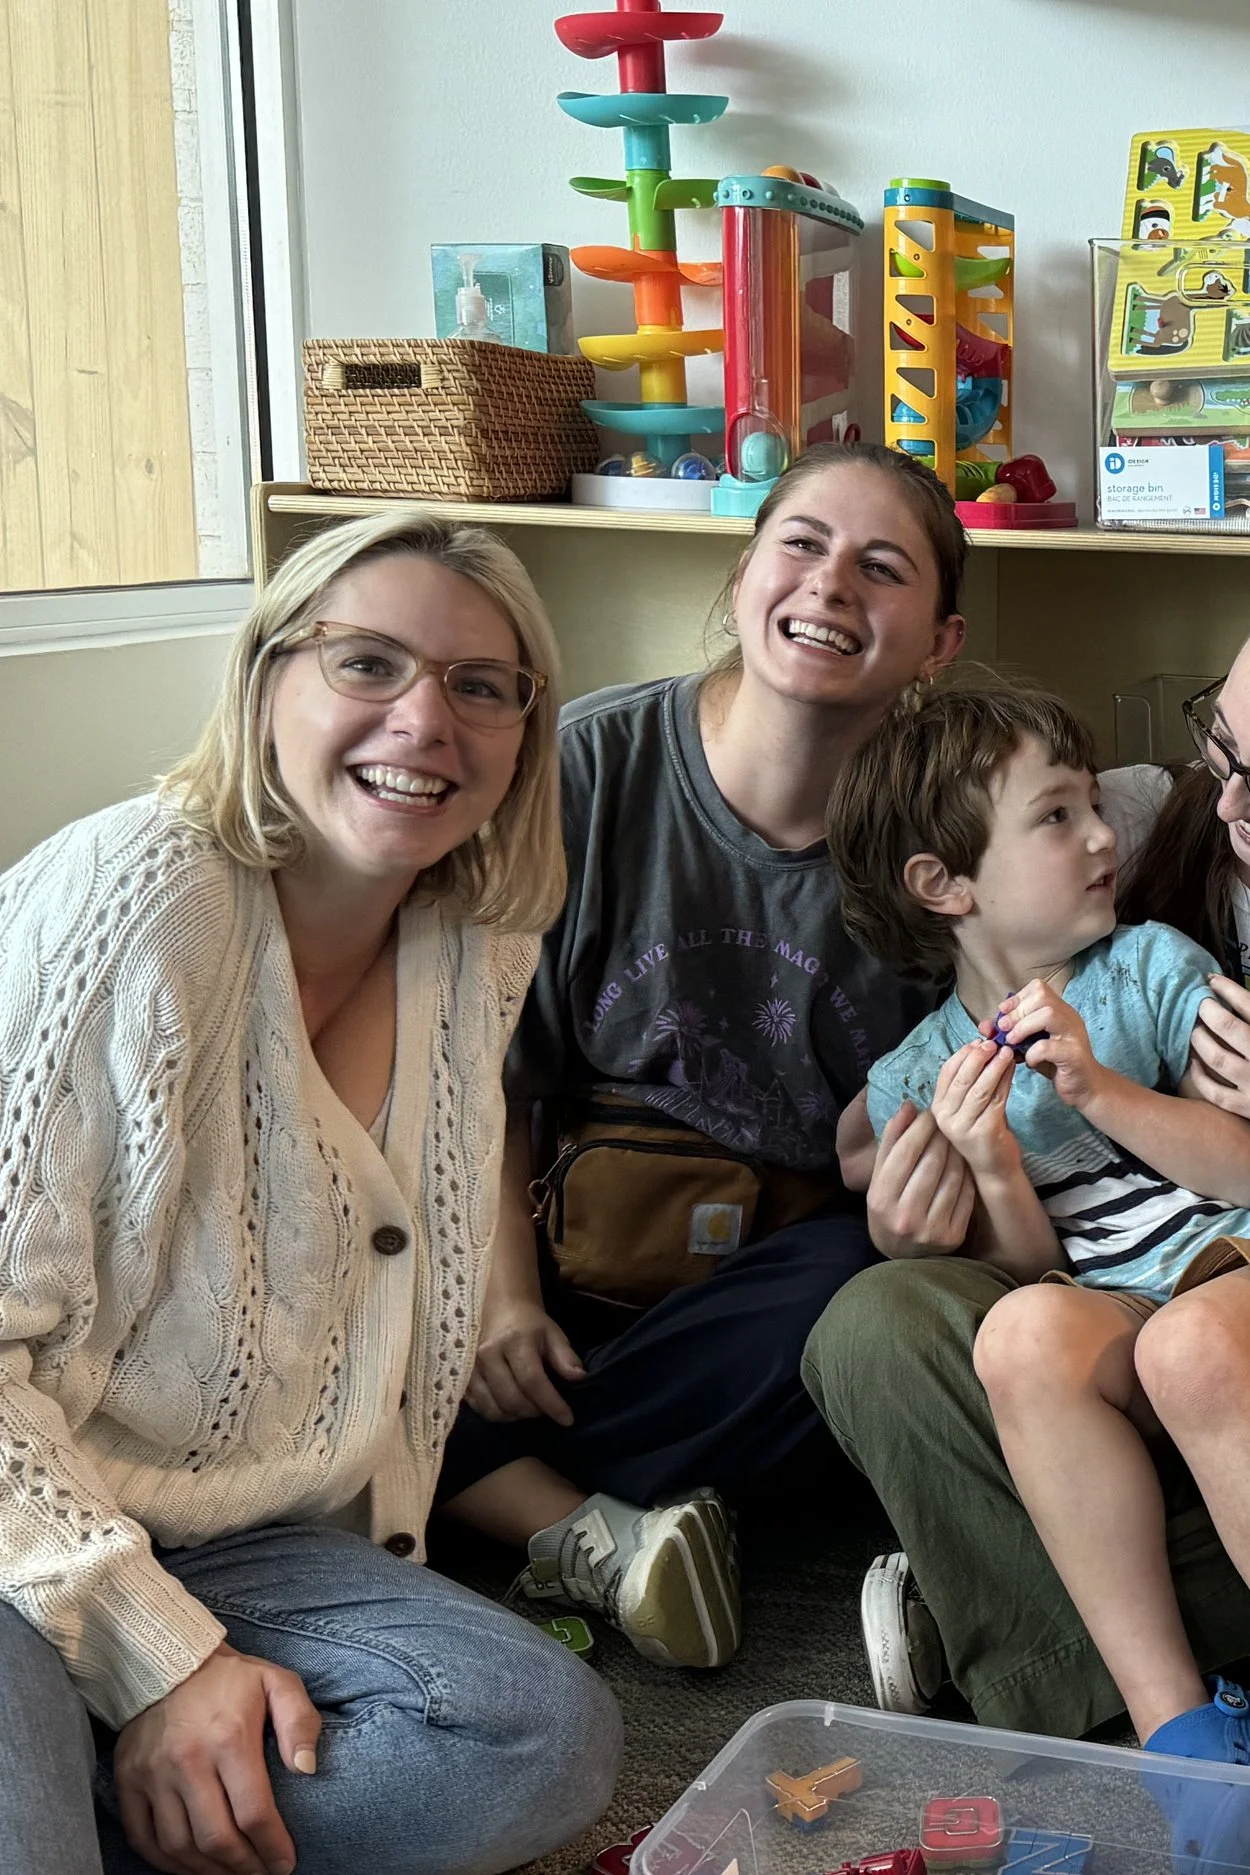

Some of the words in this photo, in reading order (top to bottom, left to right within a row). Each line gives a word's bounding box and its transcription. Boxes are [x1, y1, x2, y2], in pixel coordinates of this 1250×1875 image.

[1107, 484, 1145, 495] storage
[1147, 482, 1164, 493] bin
[623, 943, 669, 983] LIVE
[677, 929, 713, 950] ALL
[720, 928, 768, 948] THE
[774, 939, 829, 987] MAGC
[829, 985, 858, 1022] WE
